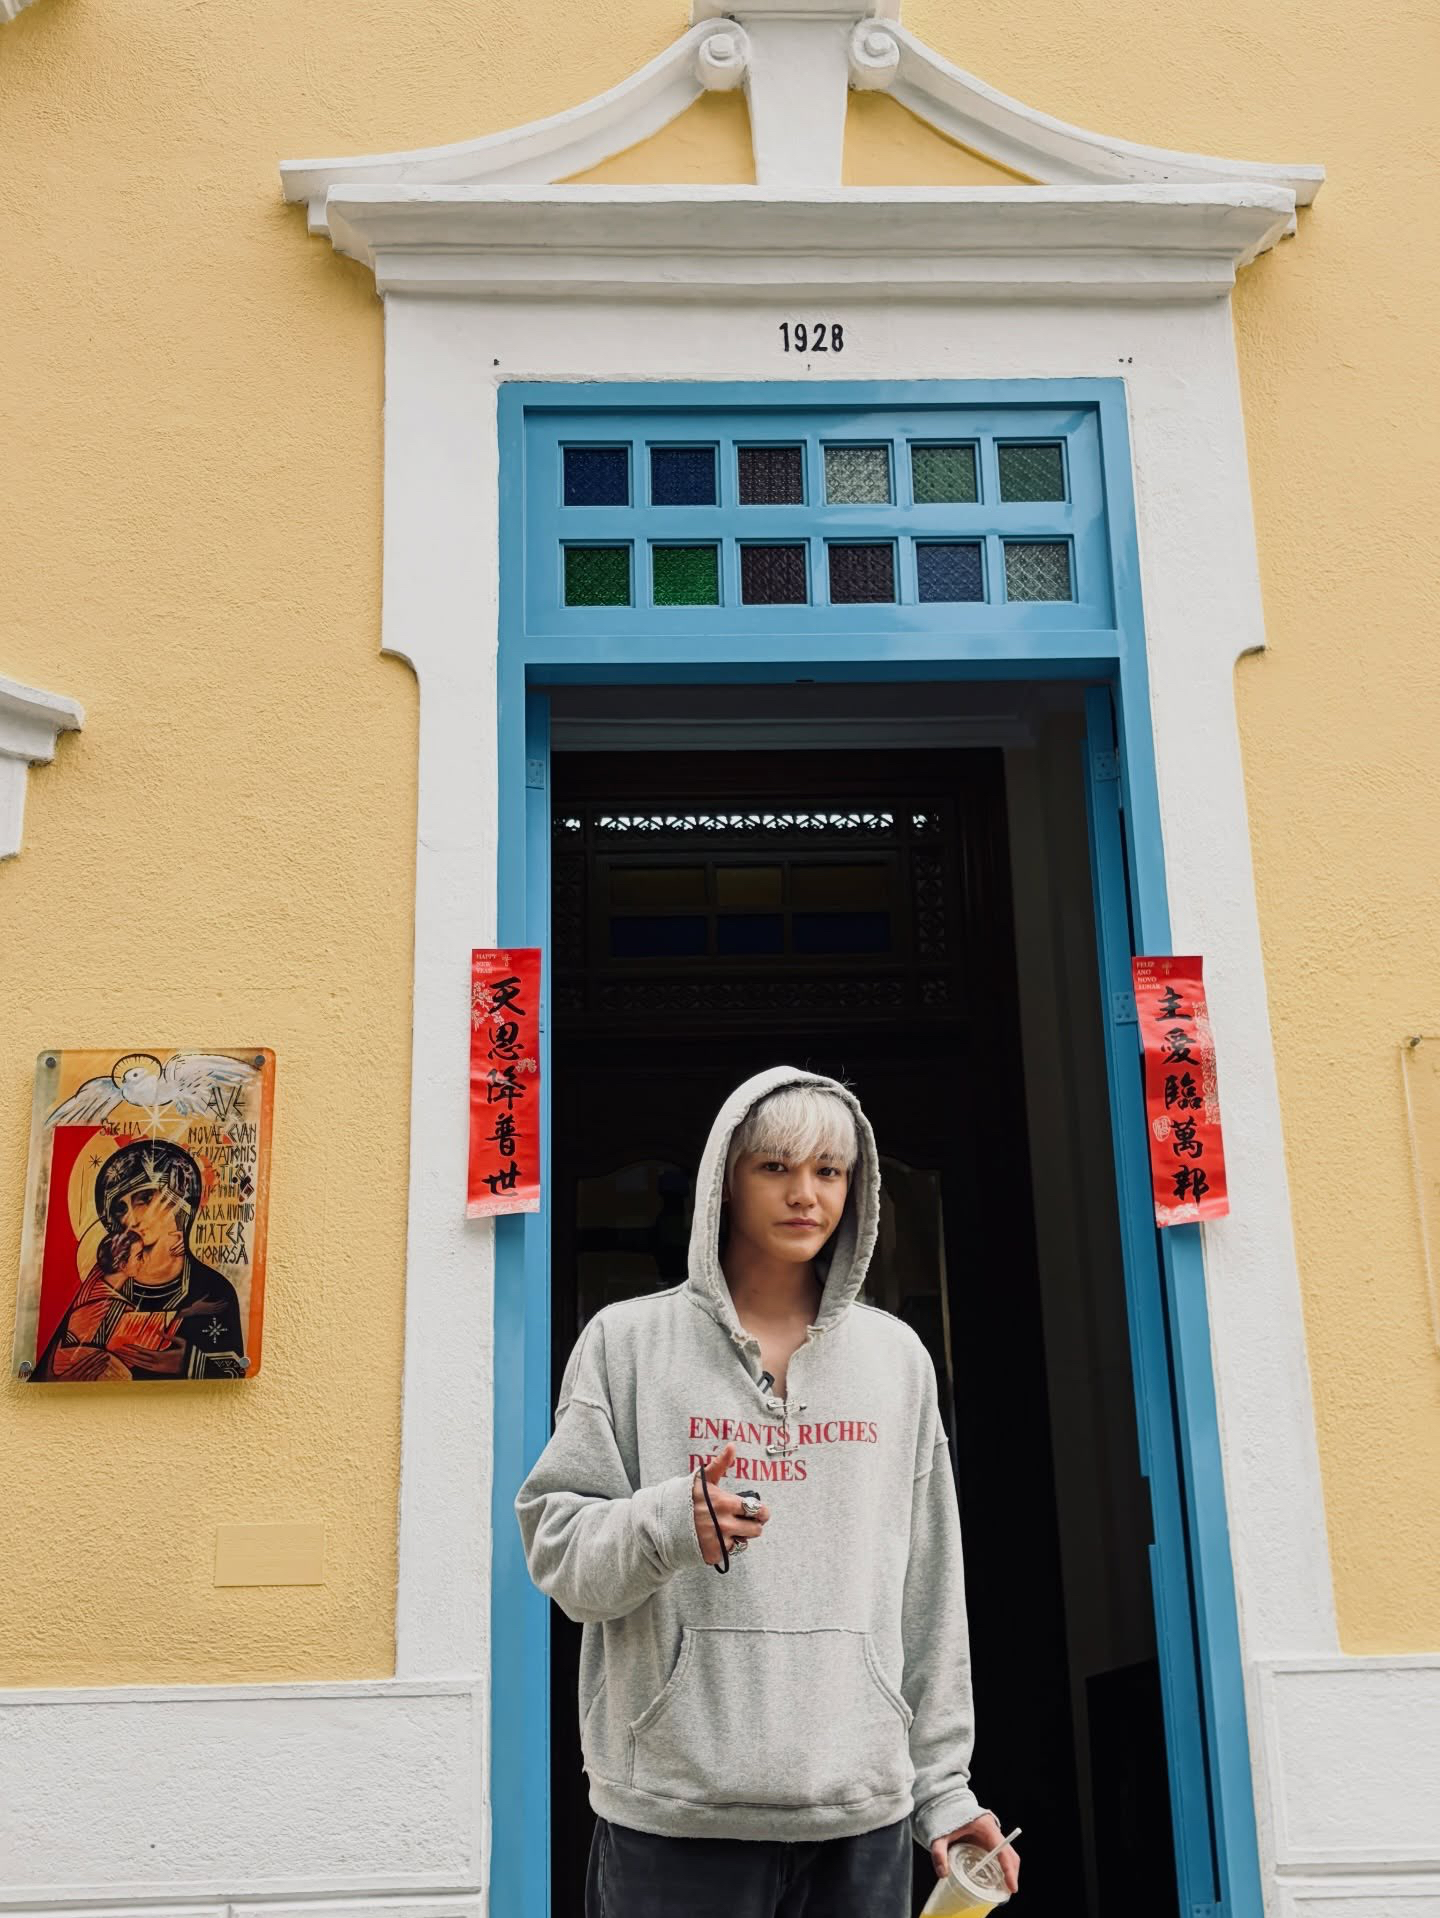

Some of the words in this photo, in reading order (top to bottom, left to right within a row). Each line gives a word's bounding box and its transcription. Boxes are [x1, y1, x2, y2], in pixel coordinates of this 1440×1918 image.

[778, 322, 844, 353] 1928
[1136, 961, 1156, 969] FELIZ
[1136, 969, 1152, 977] ANO
[1155, 985, 1210, 1208] 主愛臨萬邦
[187, 1123, 224, 1145] NOVAE
[195, 1221, 246, 1245] MATER
[688, 1416, 791, 1447] ENFANTS
[798, 1420, 879, 1446] RICHES
